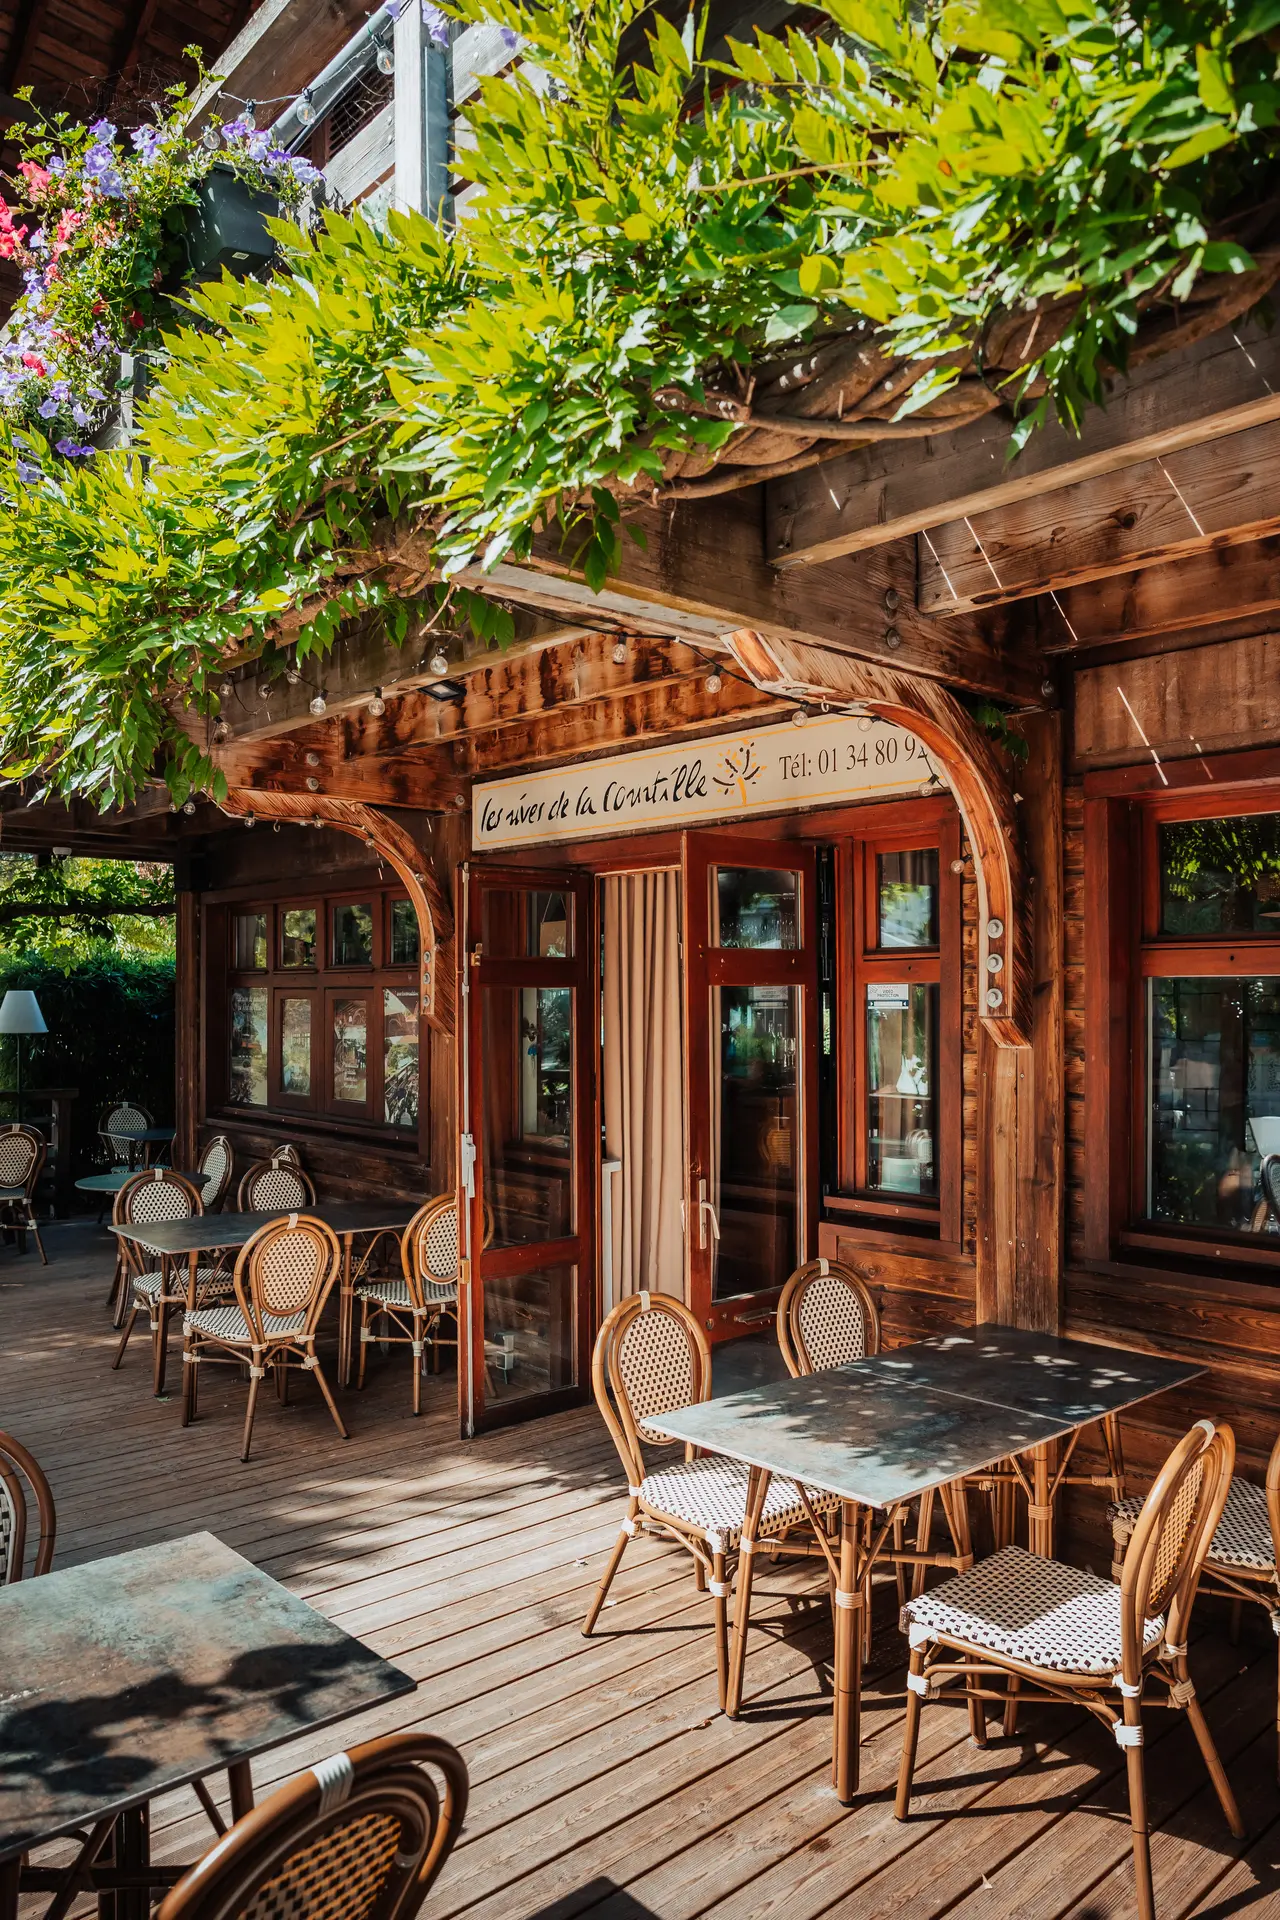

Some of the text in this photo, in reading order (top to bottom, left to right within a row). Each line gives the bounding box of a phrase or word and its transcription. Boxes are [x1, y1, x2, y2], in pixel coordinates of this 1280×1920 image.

[779, 753, 811, 780] Tél:
[818, 747, 837, 774] 01
[846, 742, 868, 770] 34
[875, 737, 898, 766] 80
[506, 793, 545, 826] rives
[548, 790, 569, 819] de
[575, 786, 597, 817] la
[603, 759, 708, 812] Courtille
